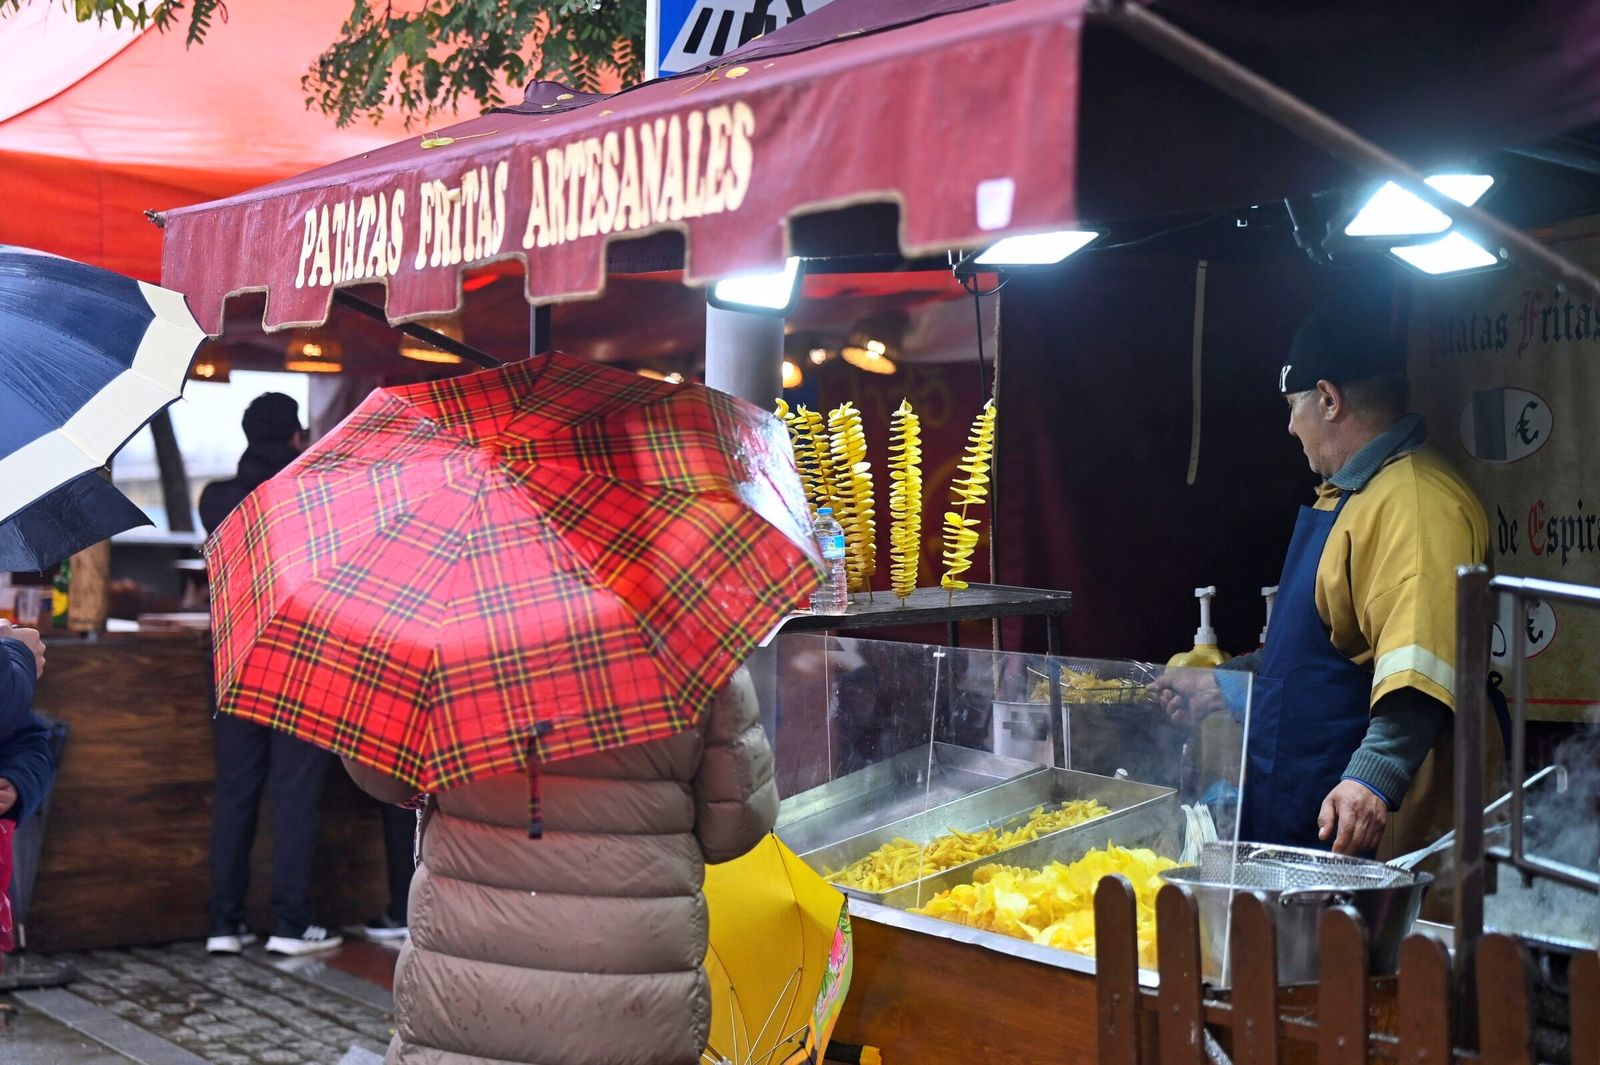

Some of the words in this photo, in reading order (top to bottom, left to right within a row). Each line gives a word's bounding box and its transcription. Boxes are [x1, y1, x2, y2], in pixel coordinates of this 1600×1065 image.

[295, 189, 405, 289] PATATAS
[522, 101, 756, 250] ARTESANALES
[1424, 312, 1509, 354] atatas
[1497, 503, 1519, 556] de
[1527, 498, 1600, 567] Espir
